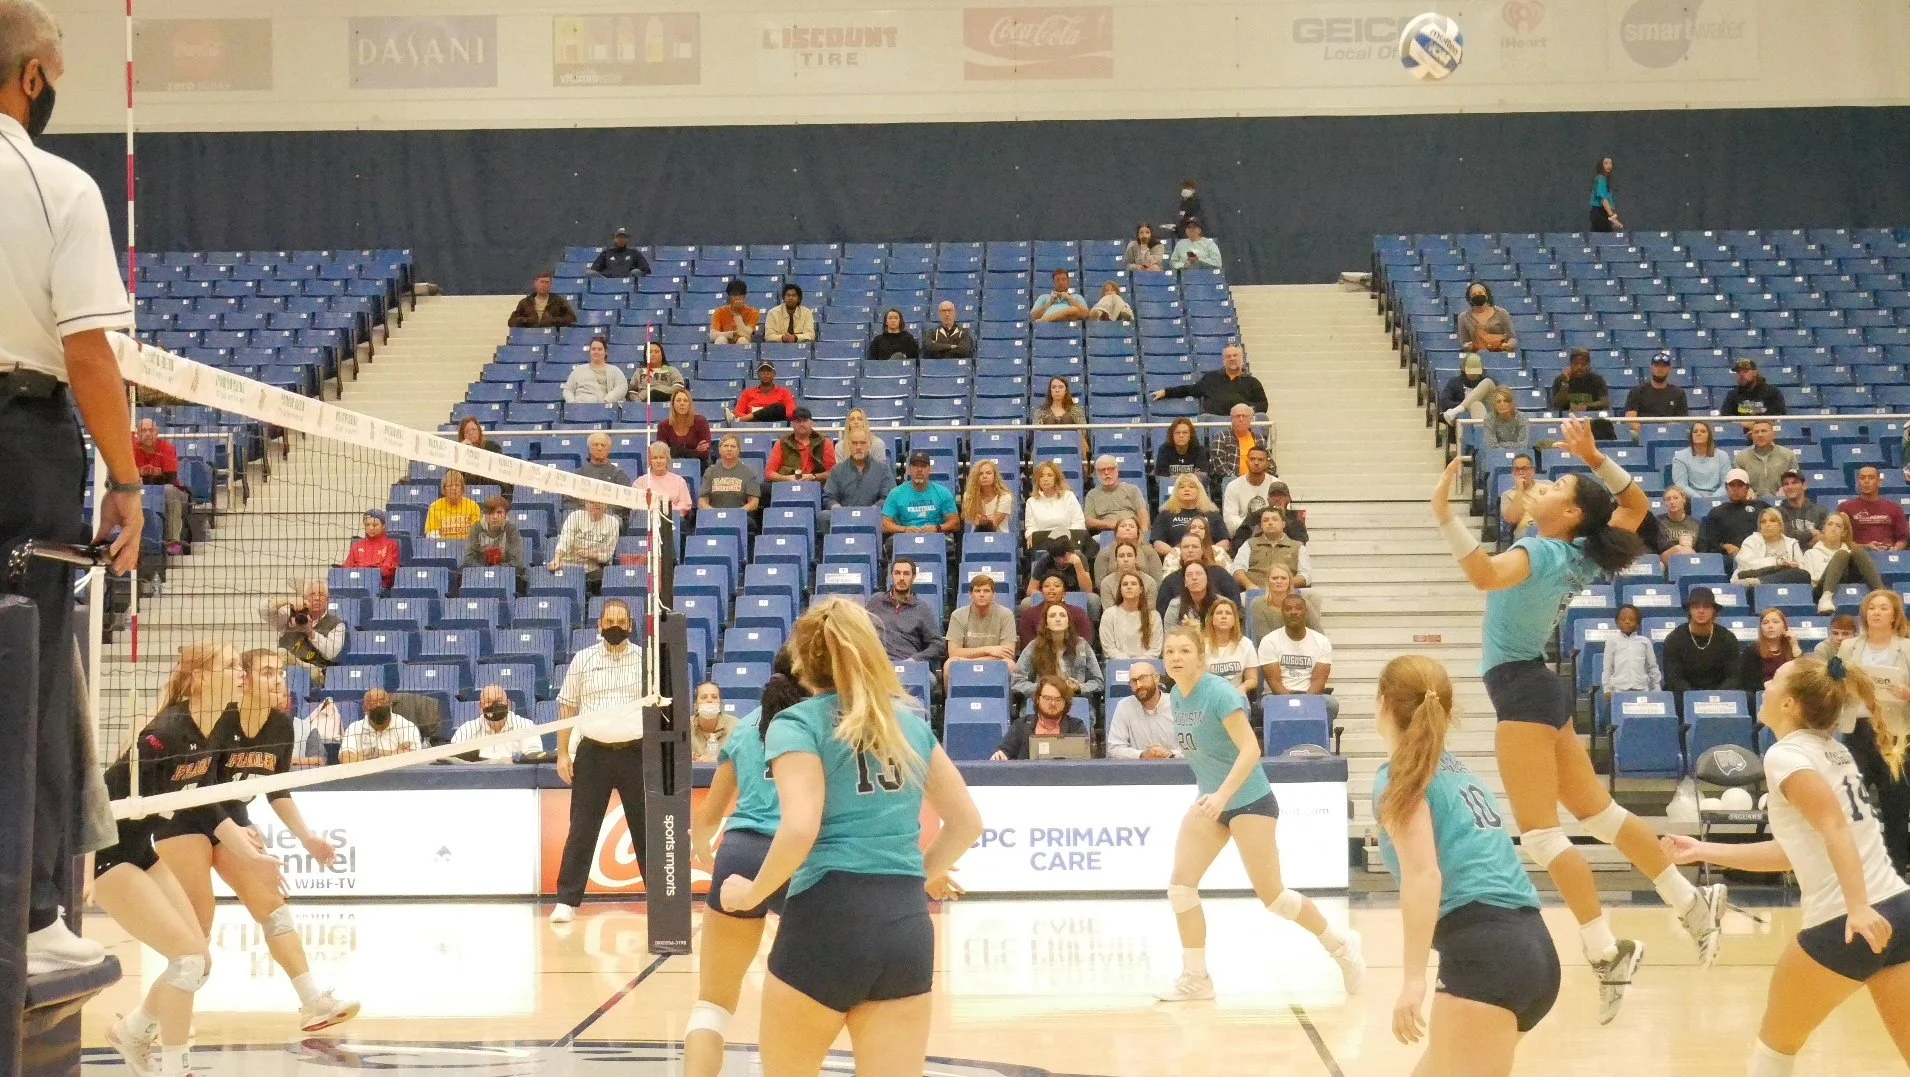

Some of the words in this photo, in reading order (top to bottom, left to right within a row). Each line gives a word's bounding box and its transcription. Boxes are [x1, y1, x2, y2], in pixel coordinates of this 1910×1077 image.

[763, 26, 898, 49] DISCOUNT
[988, 15, 1082, 46] Coca-Cola
[1293, 16, 1401, 43] GEIC
[357, 36, 485, 66] DASANI
[800, 52, 859, 65] TIRE
[1323, 45, 1370, 60] Local
[1210, 661, 1242, 674] AUGUSTA
[1280, 654, 1312, 667] AUGUSTA
[1178, 732, 1197, 751] 20
[1457, 782, 1503, 830] 10
[663, 814, 676, 850] sports
[970, 828, 1017, 848] PC
[1029, 826, 1151, 847] PRIMARY
[1030, 851, 1102, 871] CARE
[663, 851, 677, 897] imports
